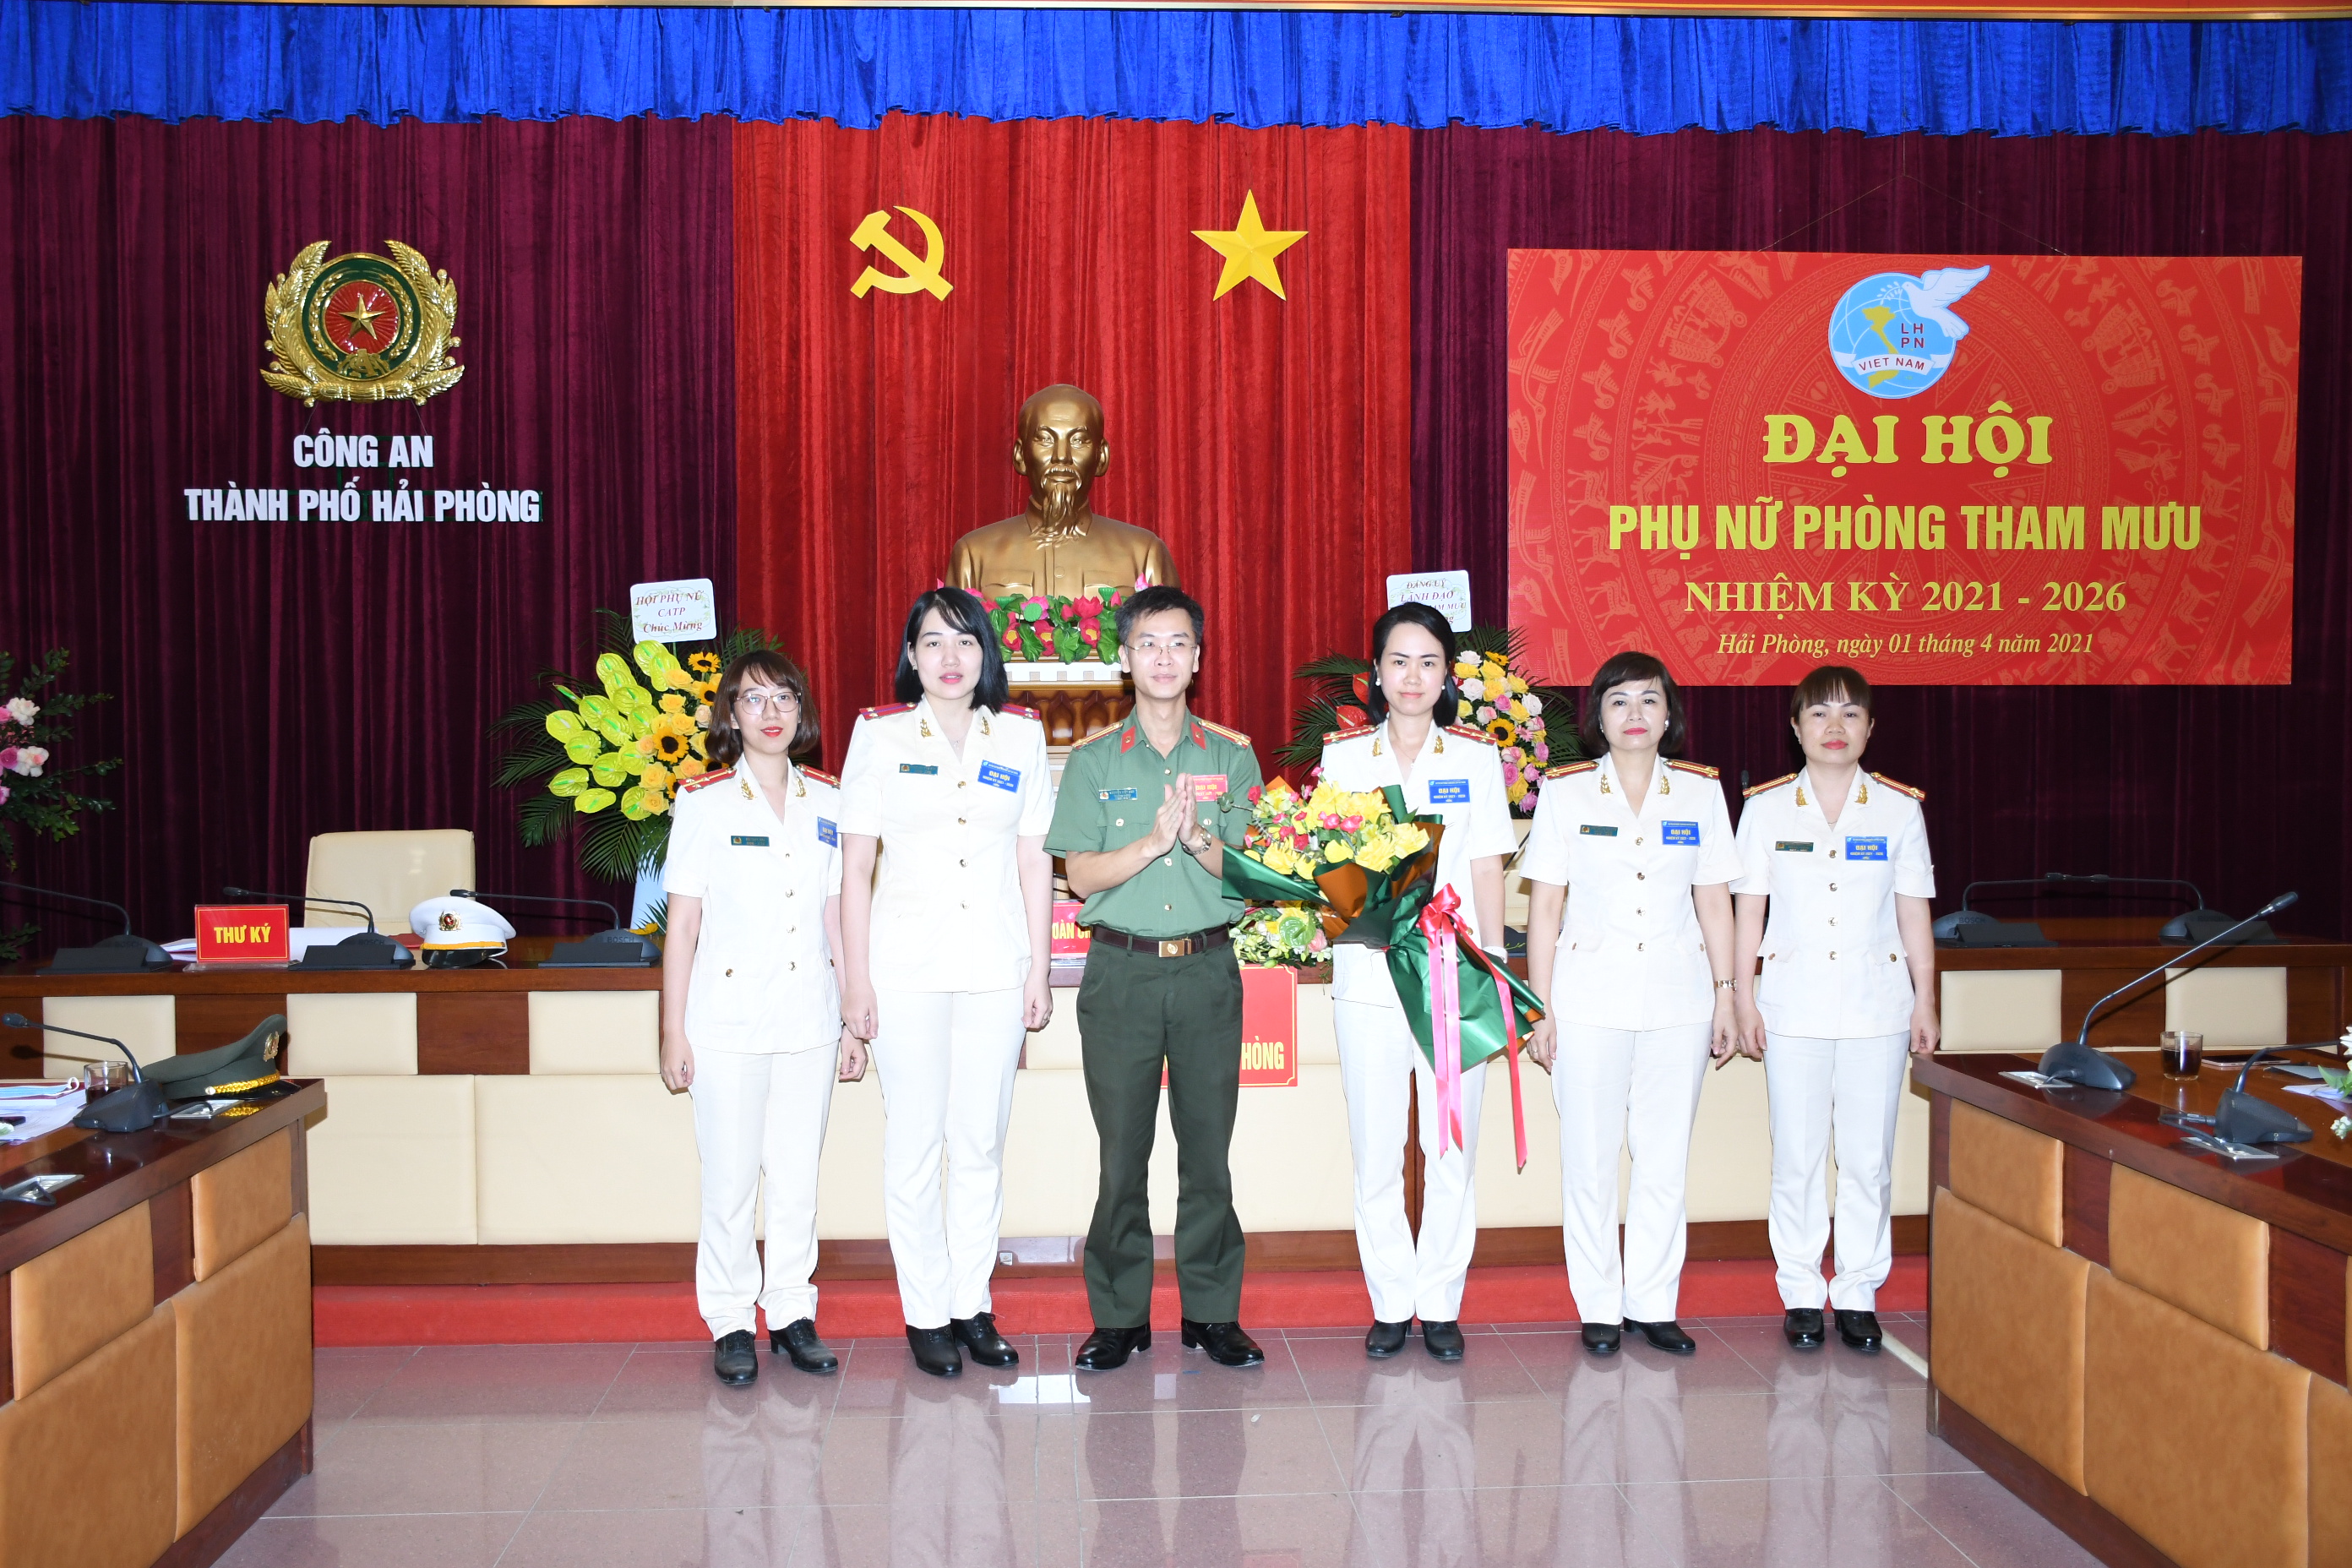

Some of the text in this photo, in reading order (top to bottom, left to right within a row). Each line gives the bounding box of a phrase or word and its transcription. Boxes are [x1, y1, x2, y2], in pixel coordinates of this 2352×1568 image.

[1901, 323, 1925, 335] LH
[1901, 338, 1925, 349] PN
[1859, 357, 1925, 372] VIET NAM
[293, 427, 434, 468] CÔNG AN
[1762, 400, 2053, 477] ĐẠI HỘI
[184, 476, 540, 523] THÀNH PHỐ HẢI PHÒNG
[1609, 493, 2201, 560] PHỤ NỮ PHÒNG THAM MƯU
[660, 593, 682, 604] PHỤ
[1401, 591, 1454, 602] LÃNH ĐẠO
[1685, 572, 1835, 620] NHIỆM
[1847, 572, 1909, 612] KỲ
[1921, 581, 2004, 612] 2021
[2042, 581, 2126, 612] 2026
[658, 607, 686, 618] CATP
[643, 621, 702, 634] Chúc Mừng
[1717, 634, 2093, 658] Hải Phòng, ngày 01 tháng 4 năm 2021
[214, 923, 271, 944] THƯ KÝ
[1052, 918, 1075, 939] OÀN
[1241, 1035, 1285, 1070] HÒNG
